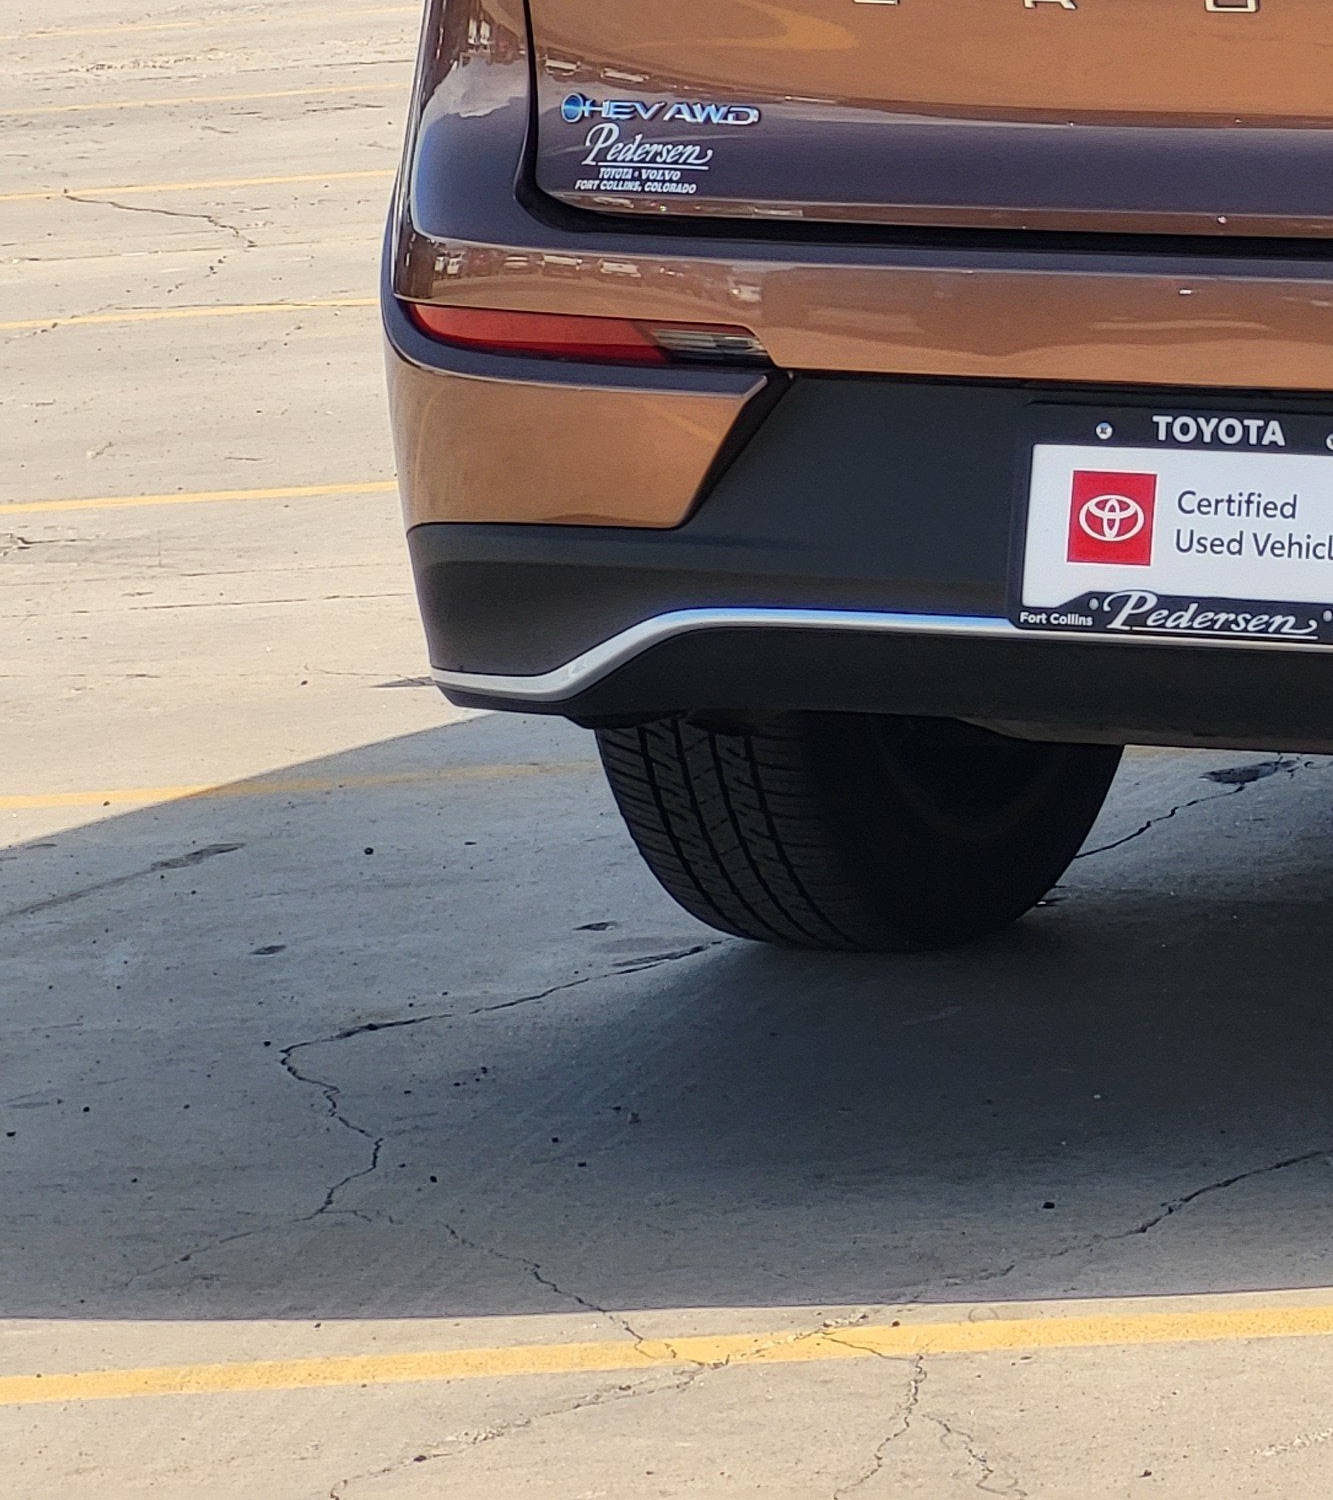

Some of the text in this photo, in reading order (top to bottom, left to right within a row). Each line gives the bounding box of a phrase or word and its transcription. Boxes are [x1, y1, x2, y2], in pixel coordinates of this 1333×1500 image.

[663, 101, 761, 126] AWD
[580, 122, 714, 167] Pedersen
[574, 180, 600, 192] FORT
[644, 181, 698, 195] COLORADO
[599, 167, 682, 182] TOYOTA VOLVO
[1152, 415, 1286, 447] TOYOTA
[1176, 489, 1298, 520] Certified
[1175, 527, 1244, 556] Used
[1020, 612, 1094, 627] Fort Collins
[1102, 589, 1319, 634] Pedersen
